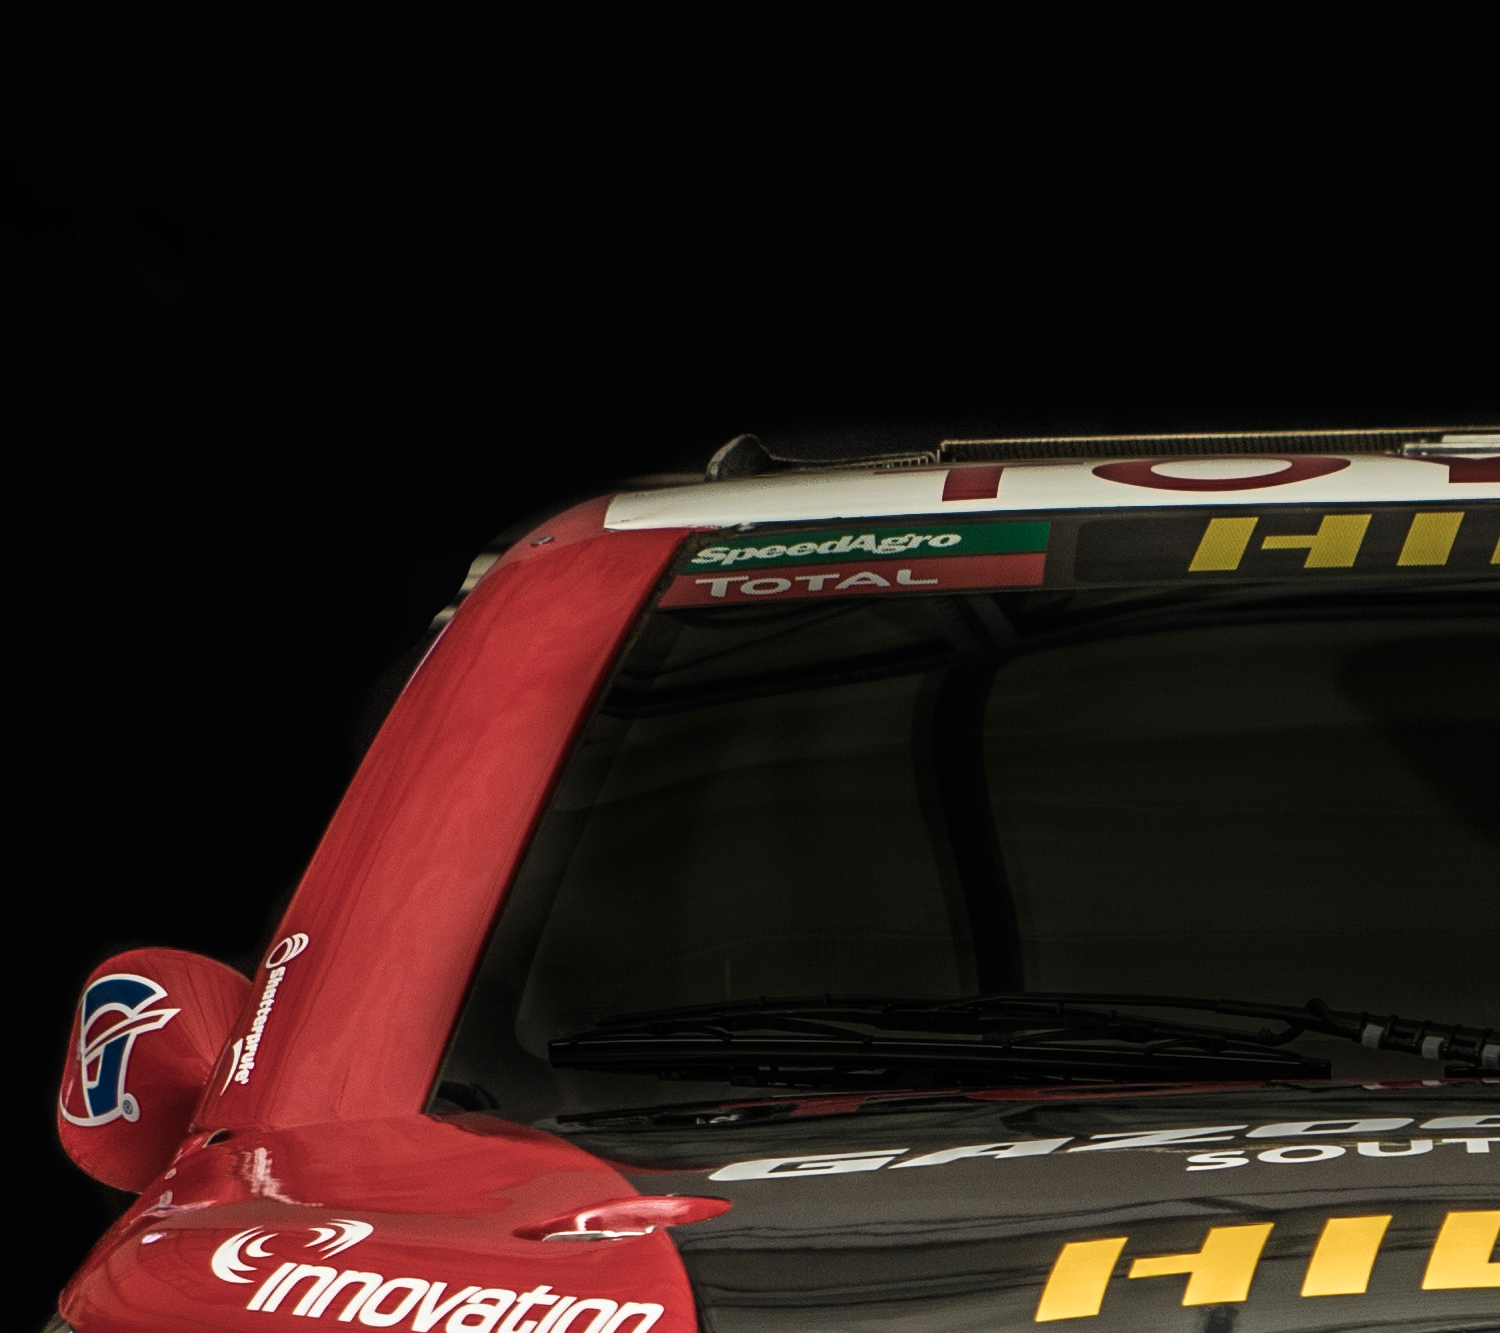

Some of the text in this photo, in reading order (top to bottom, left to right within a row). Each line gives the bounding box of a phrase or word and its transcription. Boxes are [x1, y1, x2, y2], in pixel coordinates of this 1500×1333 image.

[691, 529, 962, 567] SpeedAgro
[695, 569, 939, 598] TOTAL
[234, 966, 288, 1085] Shatterprufe
